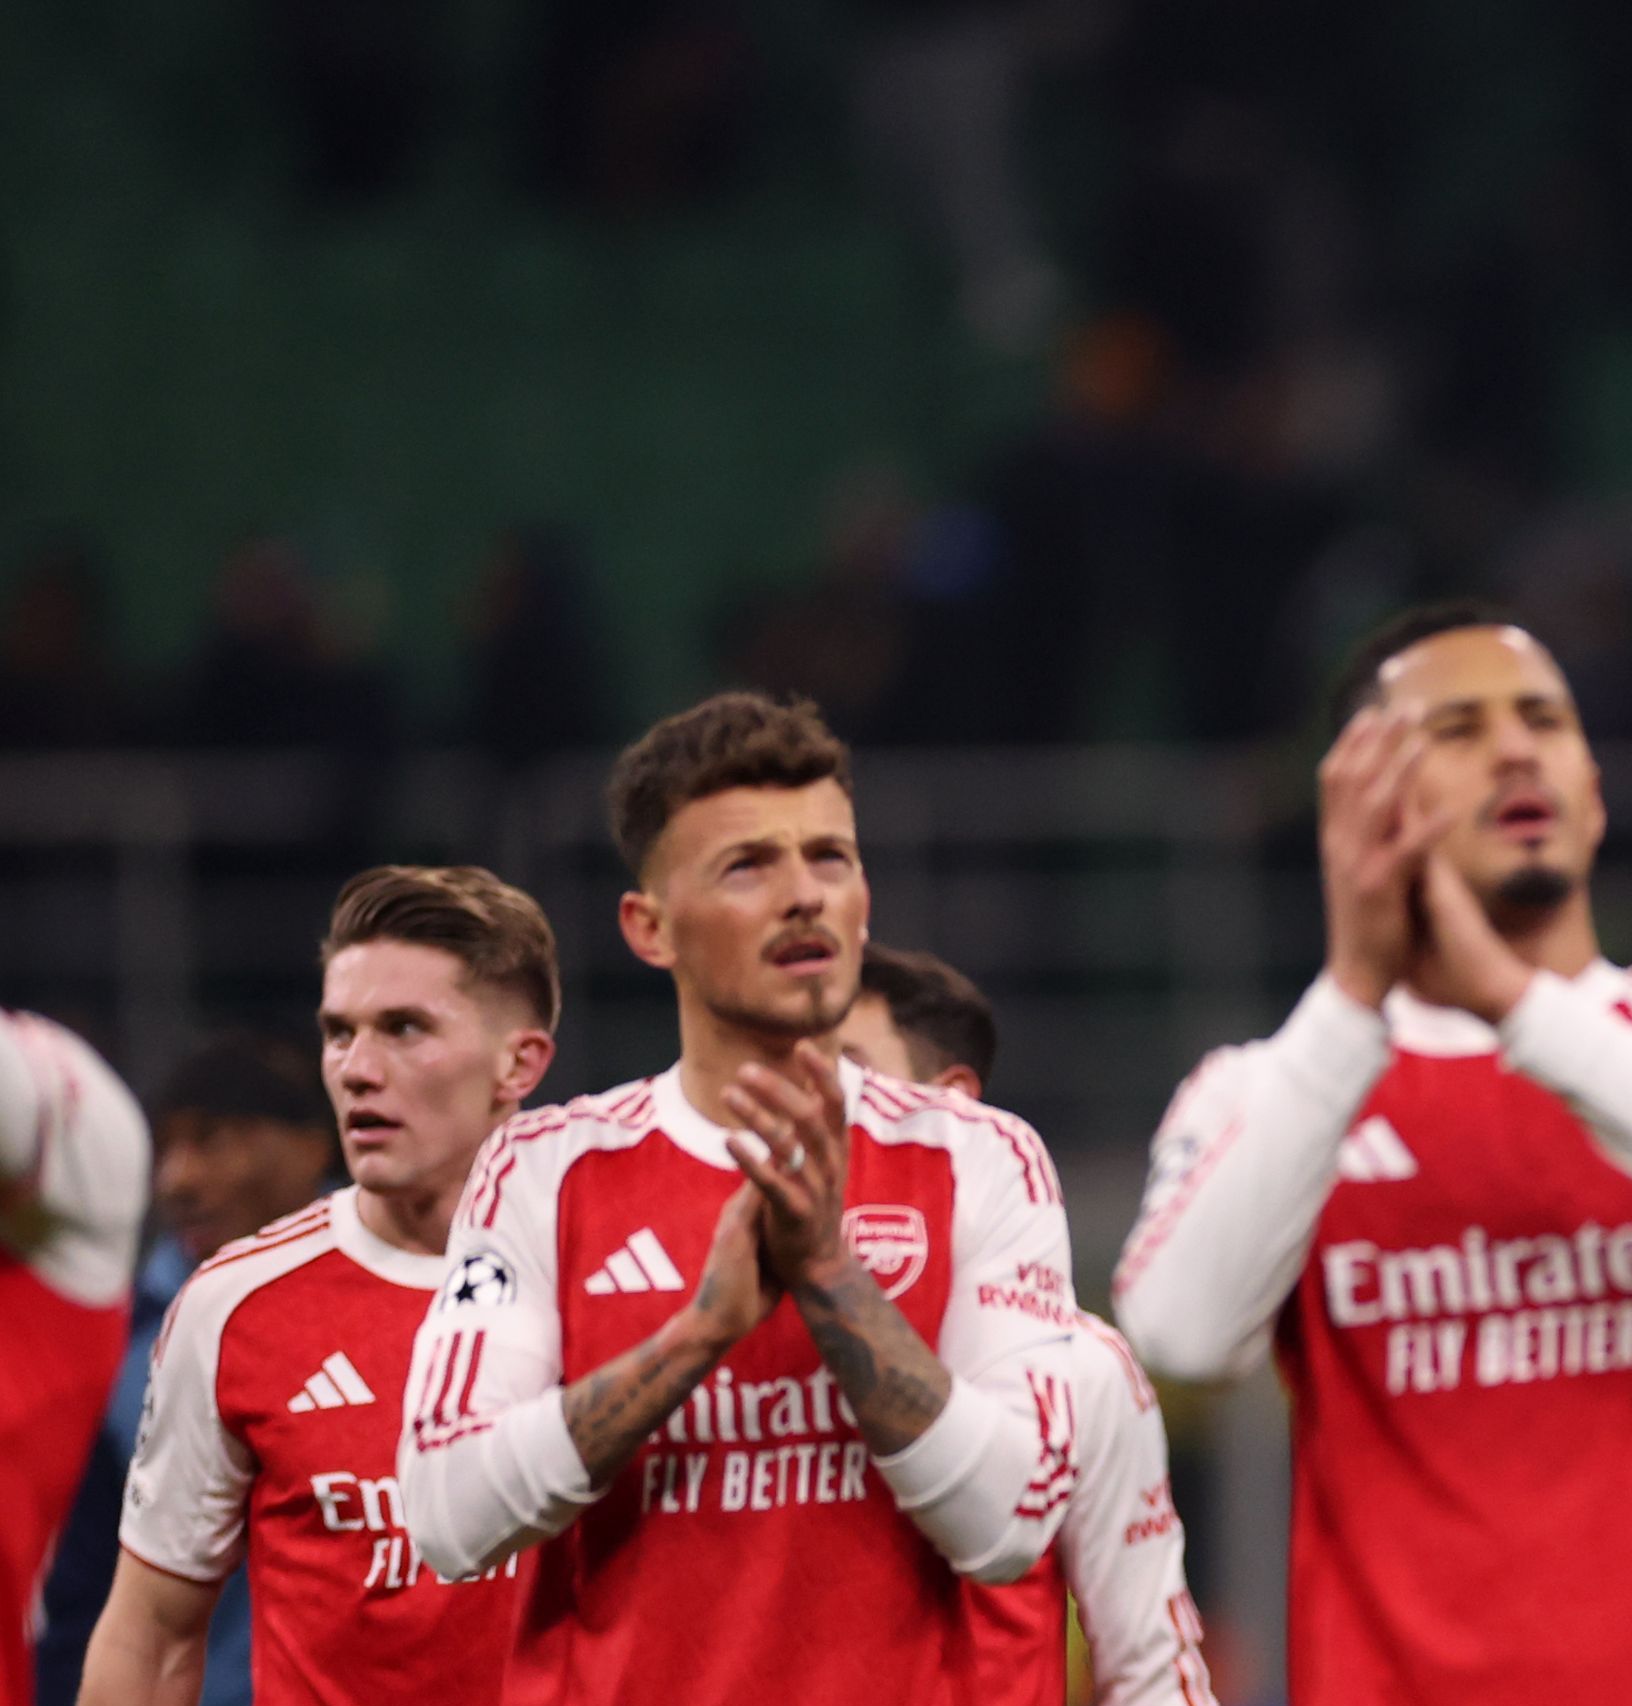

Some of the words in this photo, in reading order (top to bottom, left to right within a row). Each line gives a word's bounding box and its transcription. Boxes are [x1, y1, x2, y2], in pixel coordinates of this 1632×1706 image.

[1386, 1316, 1465, 1396] FLY
[642, 1453, 708, 1513] FLY
[721, 1440, 867, 1513] BETTER
